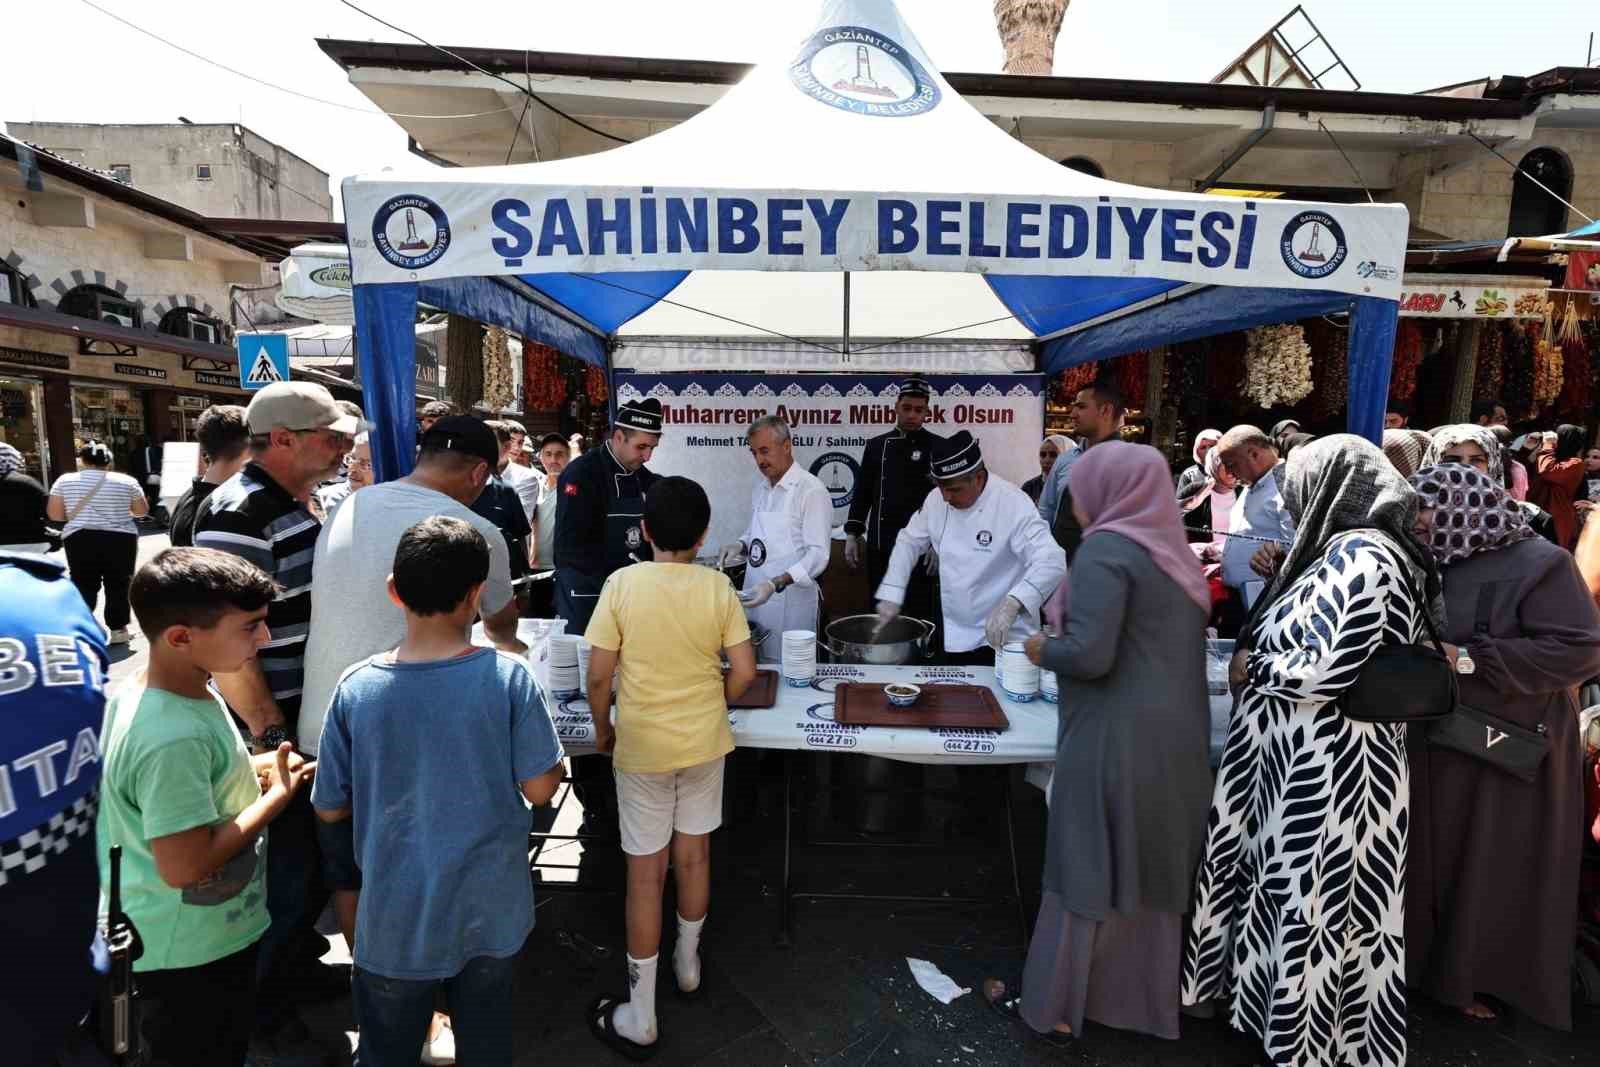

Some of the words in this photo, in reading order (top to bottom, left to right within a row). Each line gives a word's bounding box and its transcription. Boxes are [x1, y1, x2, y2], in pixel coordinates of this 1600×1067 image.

[491, 186, 851, 267] ŞAHİNBEY
[878, 196, 1258, 269] BELEDİYESİ
[776, 404, 842, 428] Ayınız
[849, 404, 946, 424] Mübek
[953, 404, 1014, 424] Olsun
[686, 436, 734, 447] Mehmet
[826, 435, 866, 448] Şahinb
[826, 735, 842, 744] 27
[964, 740, 980, 751] 27
